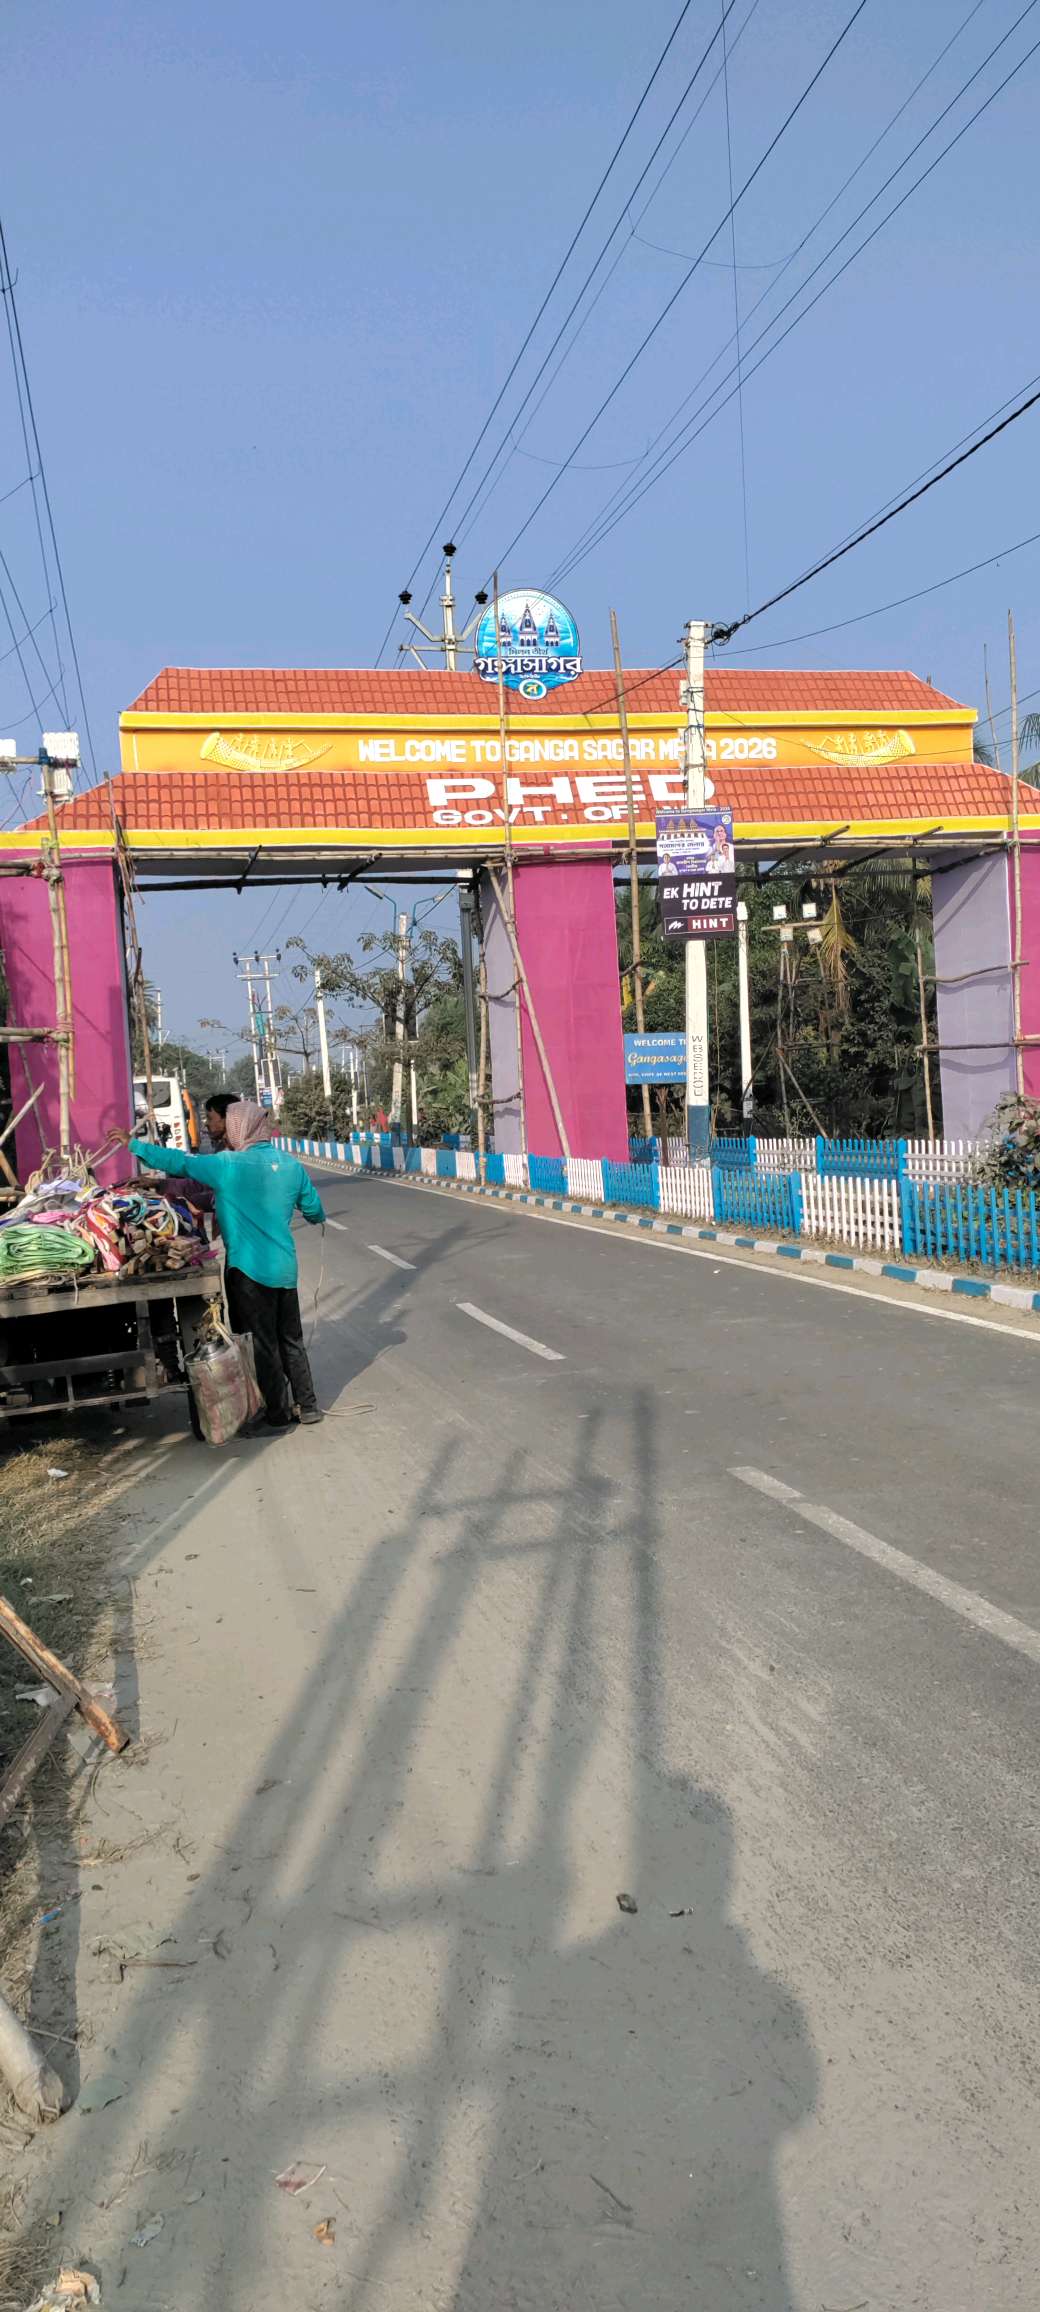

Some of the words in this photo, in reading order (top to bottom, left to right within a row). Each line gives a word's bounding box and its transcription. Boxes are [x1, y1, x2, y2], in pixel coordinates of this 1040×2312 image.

[358, 739, 467, 762] WELCOME
[470, 740, 501, 762] TO
[505, 739, 579, 762] GANGA
[582, 738, 656, 760] SAGAR
[659, 738, 717, 760] MEA
[720, 737, 777, 760] 2026
[425, 774, 715, 807] PHED
[583, 804, 640, 821] OF
[663, 887, 680, 899] EK
[682, 881, 722, 898] HINT
[682, 899, 699, 911] TO
[701, 896, 733, 910] DETE
[692, 917, 729, 930] HINT
[633, 1039, 676, 1047] WELCOME
